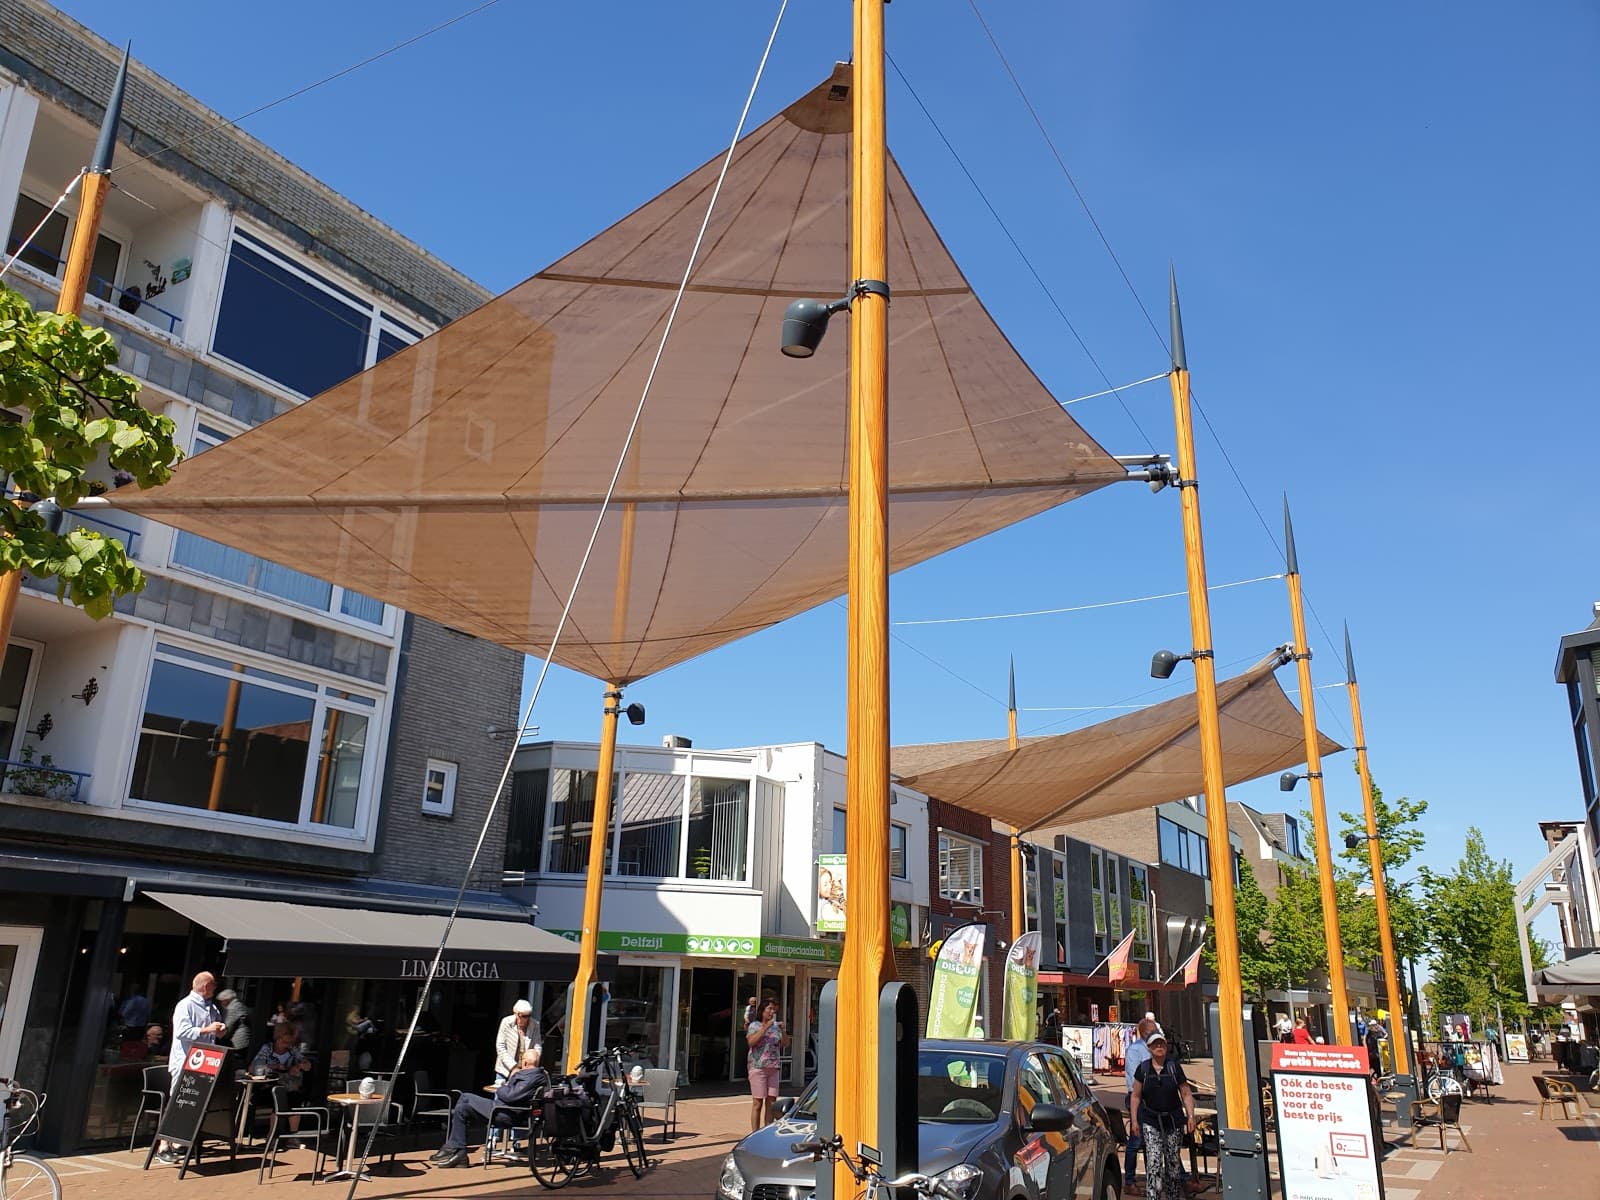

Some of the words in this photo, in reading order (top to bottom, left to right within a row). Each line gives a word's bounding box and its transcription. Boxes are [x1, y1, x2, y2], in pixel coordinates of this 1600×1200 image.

[621, 936, 663, 950] Delfzijl
[400, 959, 500, 979] LIMBURGIA
[1279, 1057, 1311, 1067] gratis
[1312, 1057, 1361, 1069] hoortest
[1305, 1080, 1318, 1089] de
[1321, 1080, 1353, 1091] beste
[1281, 1088, 1332, 1102] hoorzorg
[1283, 1101, 1307, 1109] voor
[1310, 1101, 1324, 1110] de
[1284, 1109, 1315, 1120] beste
[1317, 1112, 1343, 1124] prijs
